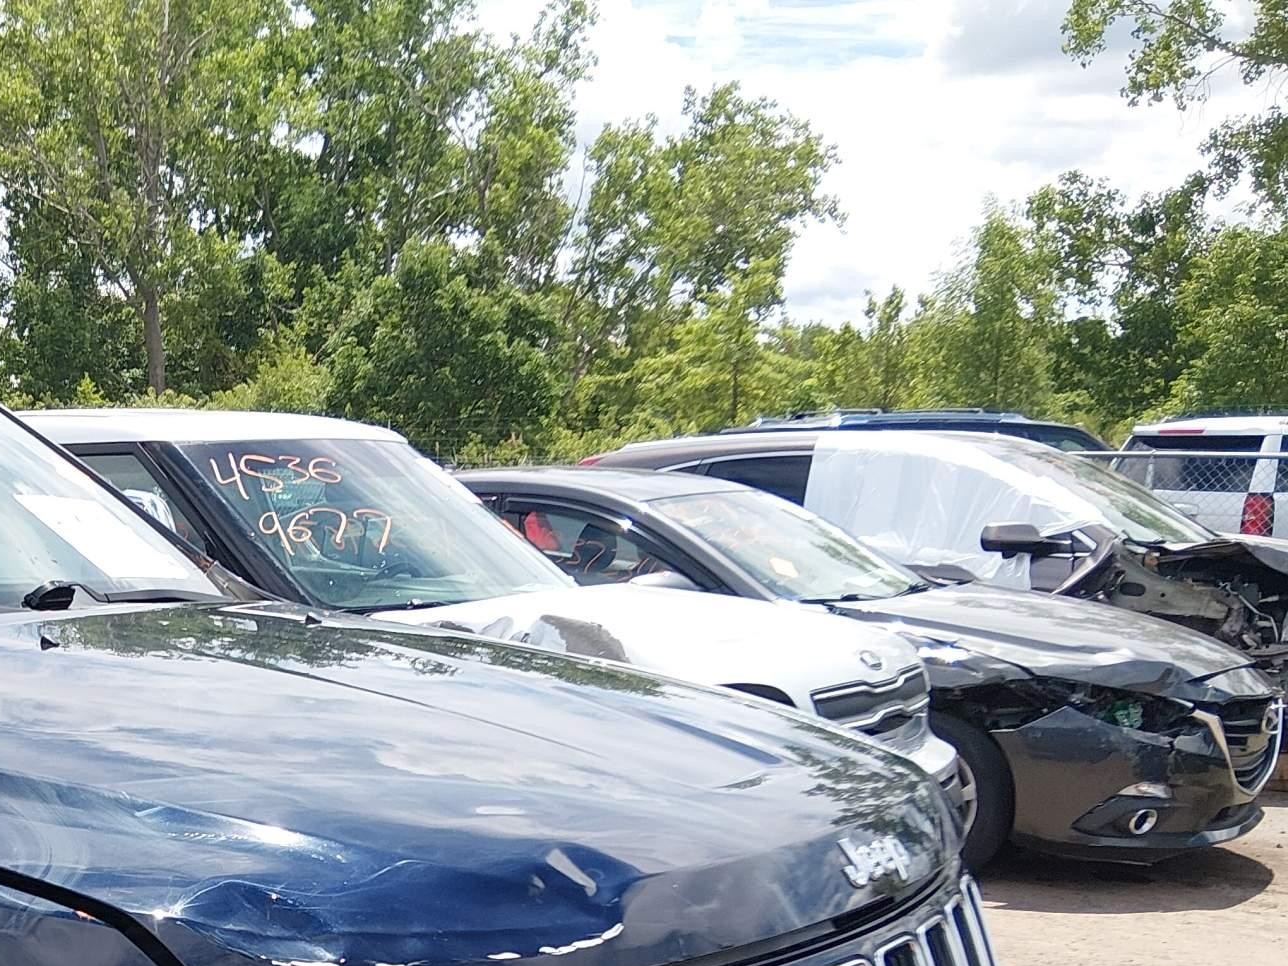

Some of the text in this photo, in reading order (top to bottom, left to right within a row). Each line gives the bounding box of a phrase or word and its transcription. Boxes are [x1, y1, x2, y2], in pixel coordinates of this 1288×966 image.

[210, 453, 342, 500] 4536
[259, 507, 392, 556] 9677
[837, 835, 911, 889] Jeep
